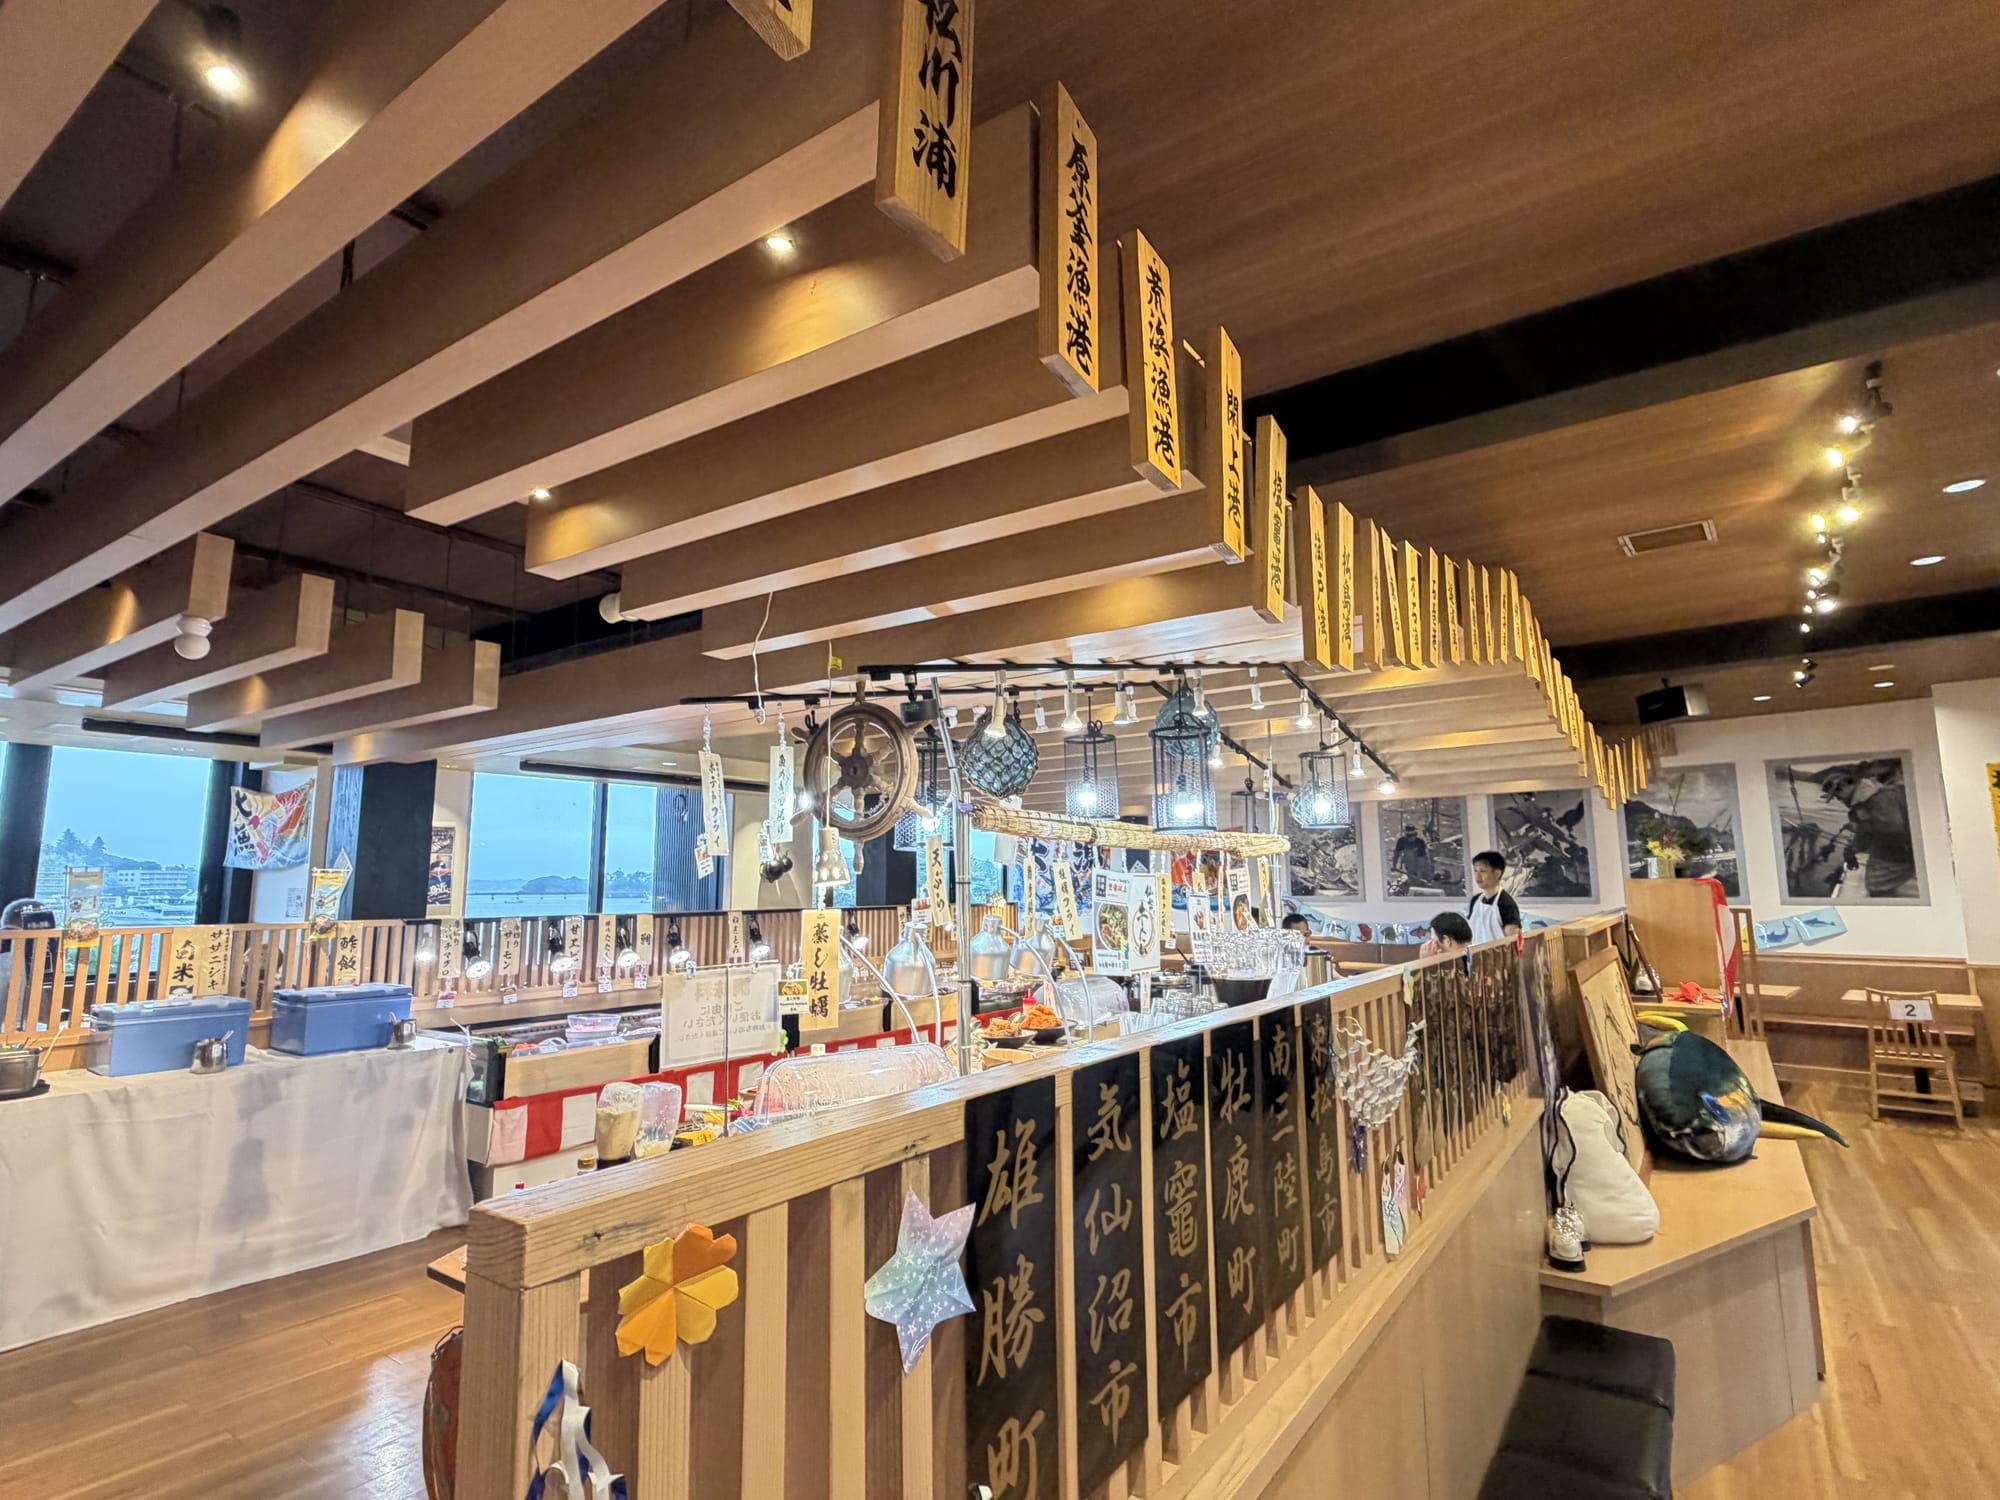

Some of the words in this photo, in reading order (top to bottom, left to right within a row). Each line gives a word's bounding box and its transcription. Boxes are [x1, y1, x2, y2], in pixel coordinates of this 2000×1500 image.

[208, 929, 223, 991] ササニシキ
[337, 934, 359, 972] 酢飯
[809, 922, 829, 1018] 蒸し牡蠣
[1904, 1004, 1917, 1017] 2
[1219, 1047, 1257, 1317] 牡鹿町
[1269, 1023, 1299, 1273] 南三陸町
[1308, 1012, 1338, 1245] 東松島市
[976, 1117, 1046, 1500] 雄勝町
